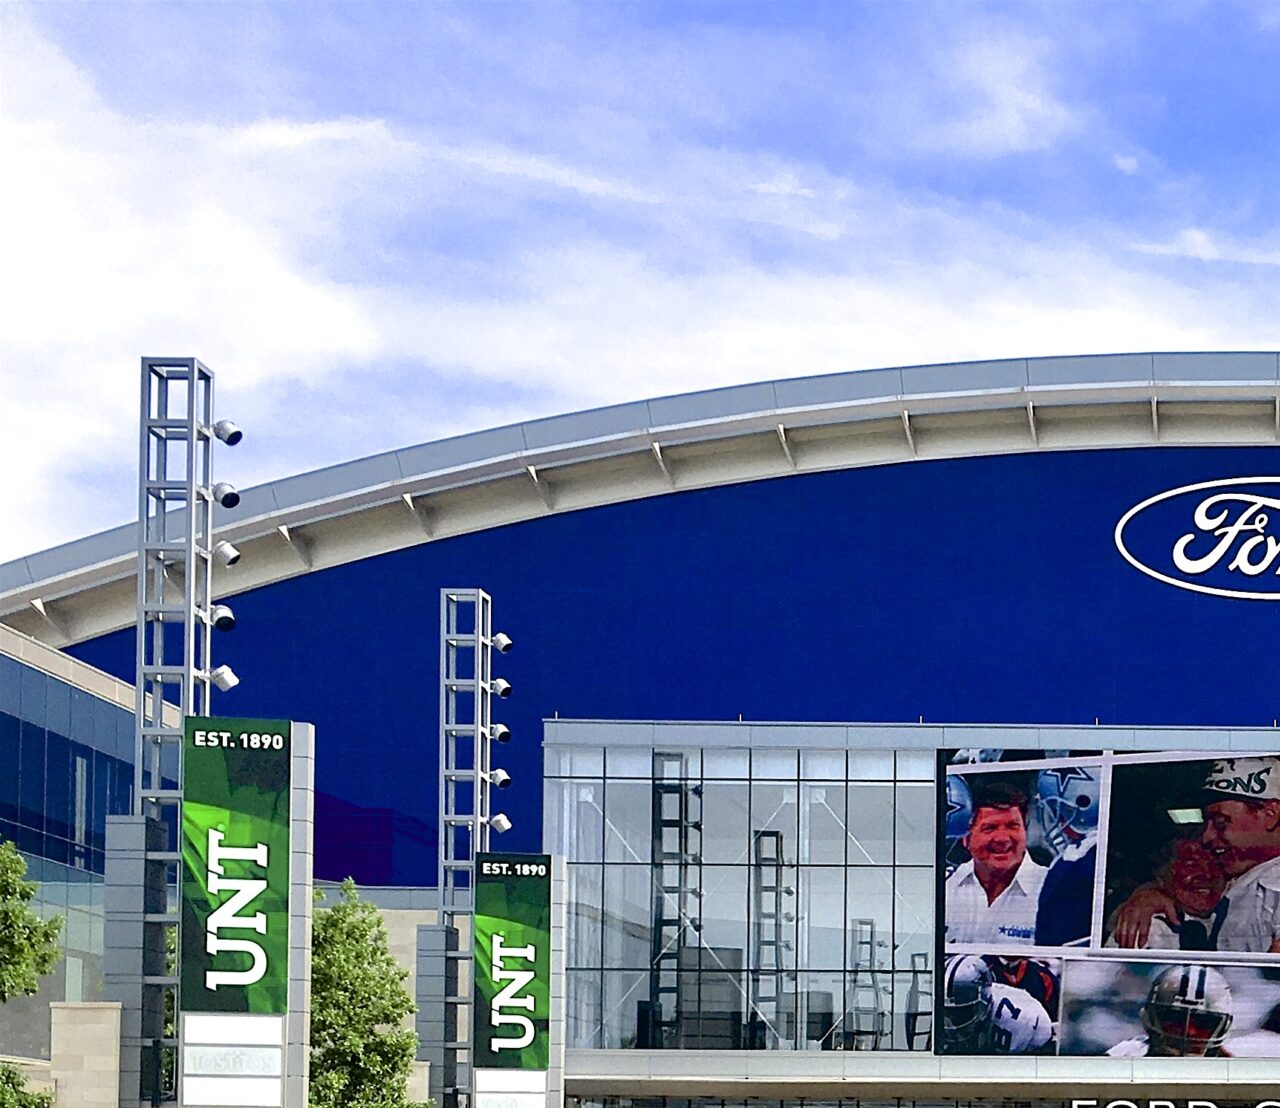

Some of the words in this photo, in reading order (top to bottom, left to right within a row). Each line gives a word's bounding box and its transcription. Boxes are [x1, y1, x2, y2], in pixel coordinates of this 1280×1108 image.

[194, 730, 236, 748] EST.
[239, 733, 283, 750] 1890
[482, 862, 512, 875] EST.
[514, 863, 546, 876] 1890
[206, 828, 268, 991] UNT
[491, 933, 536, 1053] UNT
